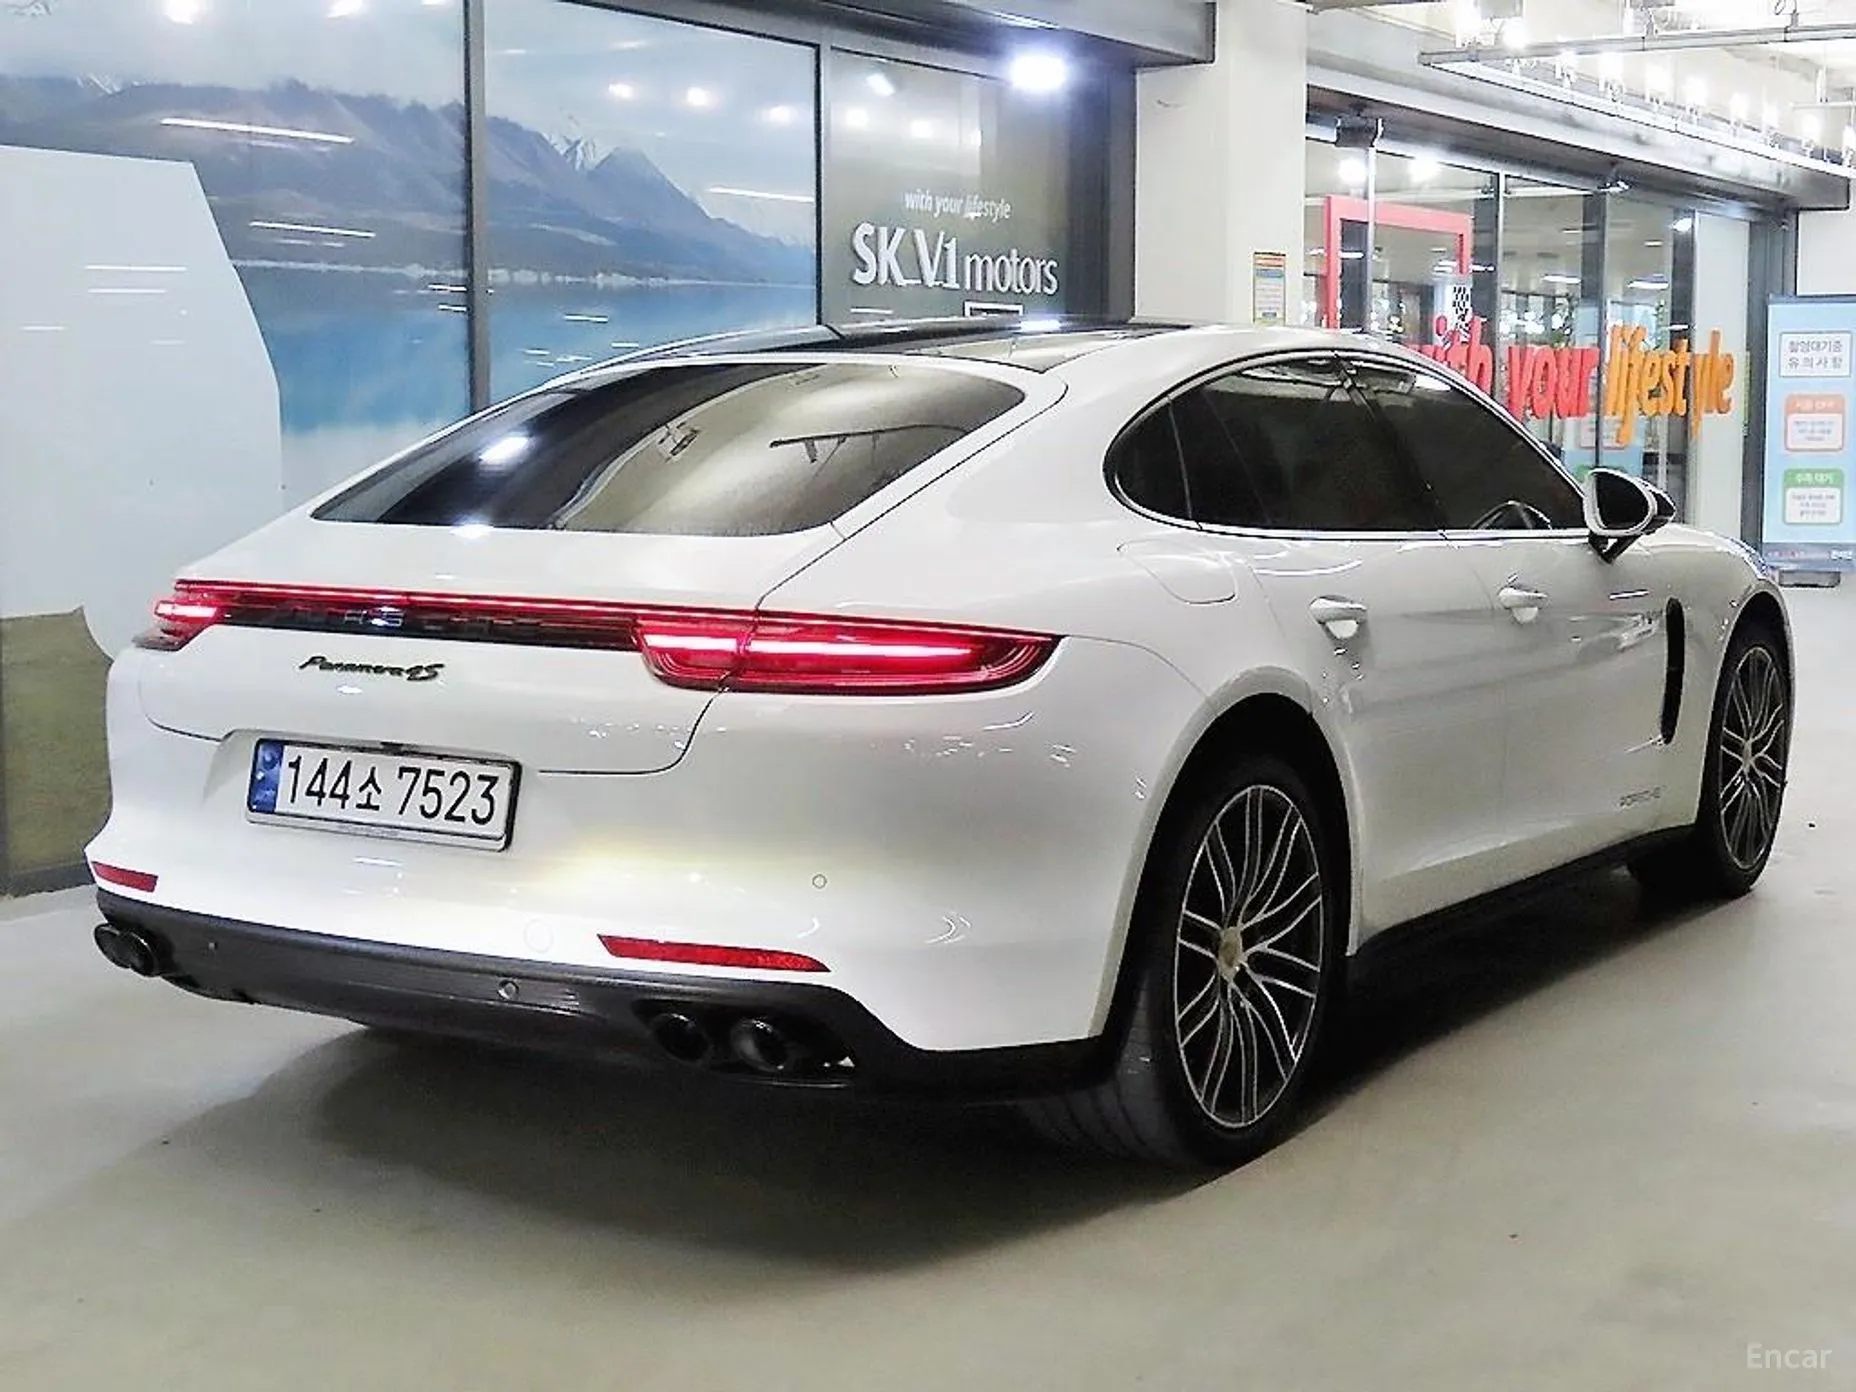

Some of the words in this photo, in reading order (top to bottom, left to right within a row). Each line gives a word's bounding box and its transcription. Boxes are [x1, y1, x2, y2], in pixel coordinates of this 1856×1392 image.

[904, 188, 933, 213] with
[934, 195, 964, 218] your
[965, 194, 1012, 223] lifestyle
[964, 247, 1058, 295] motors
[1406, 314, 1493, 396] ith
[1507, 345, 1600, 422] your
[1602, 322, 1735, 444] lifestyle
[288, 755, 382, 812] 144소
[398, 766, 499, 826] 7523
